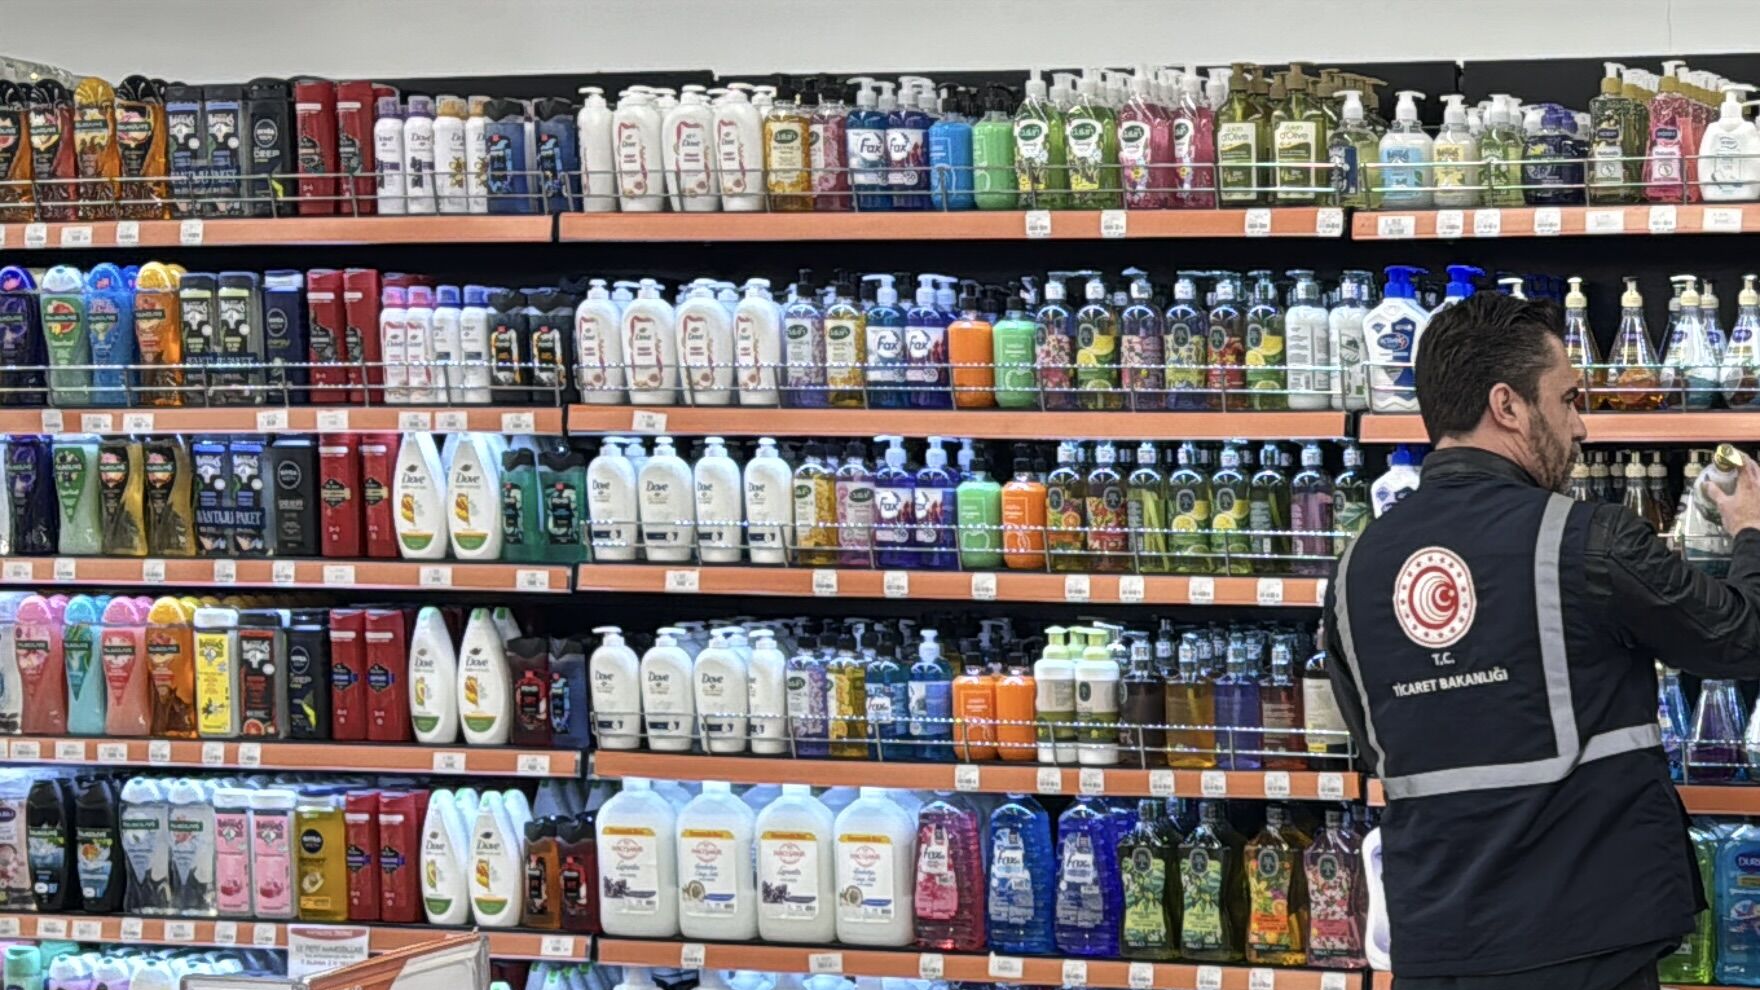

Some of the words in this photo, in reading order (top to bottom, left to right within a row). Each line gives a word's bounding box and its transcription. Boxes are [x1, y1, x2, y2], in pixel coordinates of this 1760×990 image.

[877, 335, 899, 350] Fax
[909, 335, 929, 350] Fax
[401, 472, 425, 485] Dove
[456, 472, 479, 485] Dove
[646, 480, 668, 493] Dove
[880, 497, 900, 512] Fax
[414, 656, 434, 670] Dove
[465, 656, 489, 669] Dove
[1431, 652, 1455, 666] T.C.
[594, 670, 614, 683] Dove
[648, 671, 669, 683] Dove
[702, 673, 724, 685] Dove
[1392, 677, 1437, 697] TİCARET
[1439, 666, 1509, 690] BAKANLIĞI
